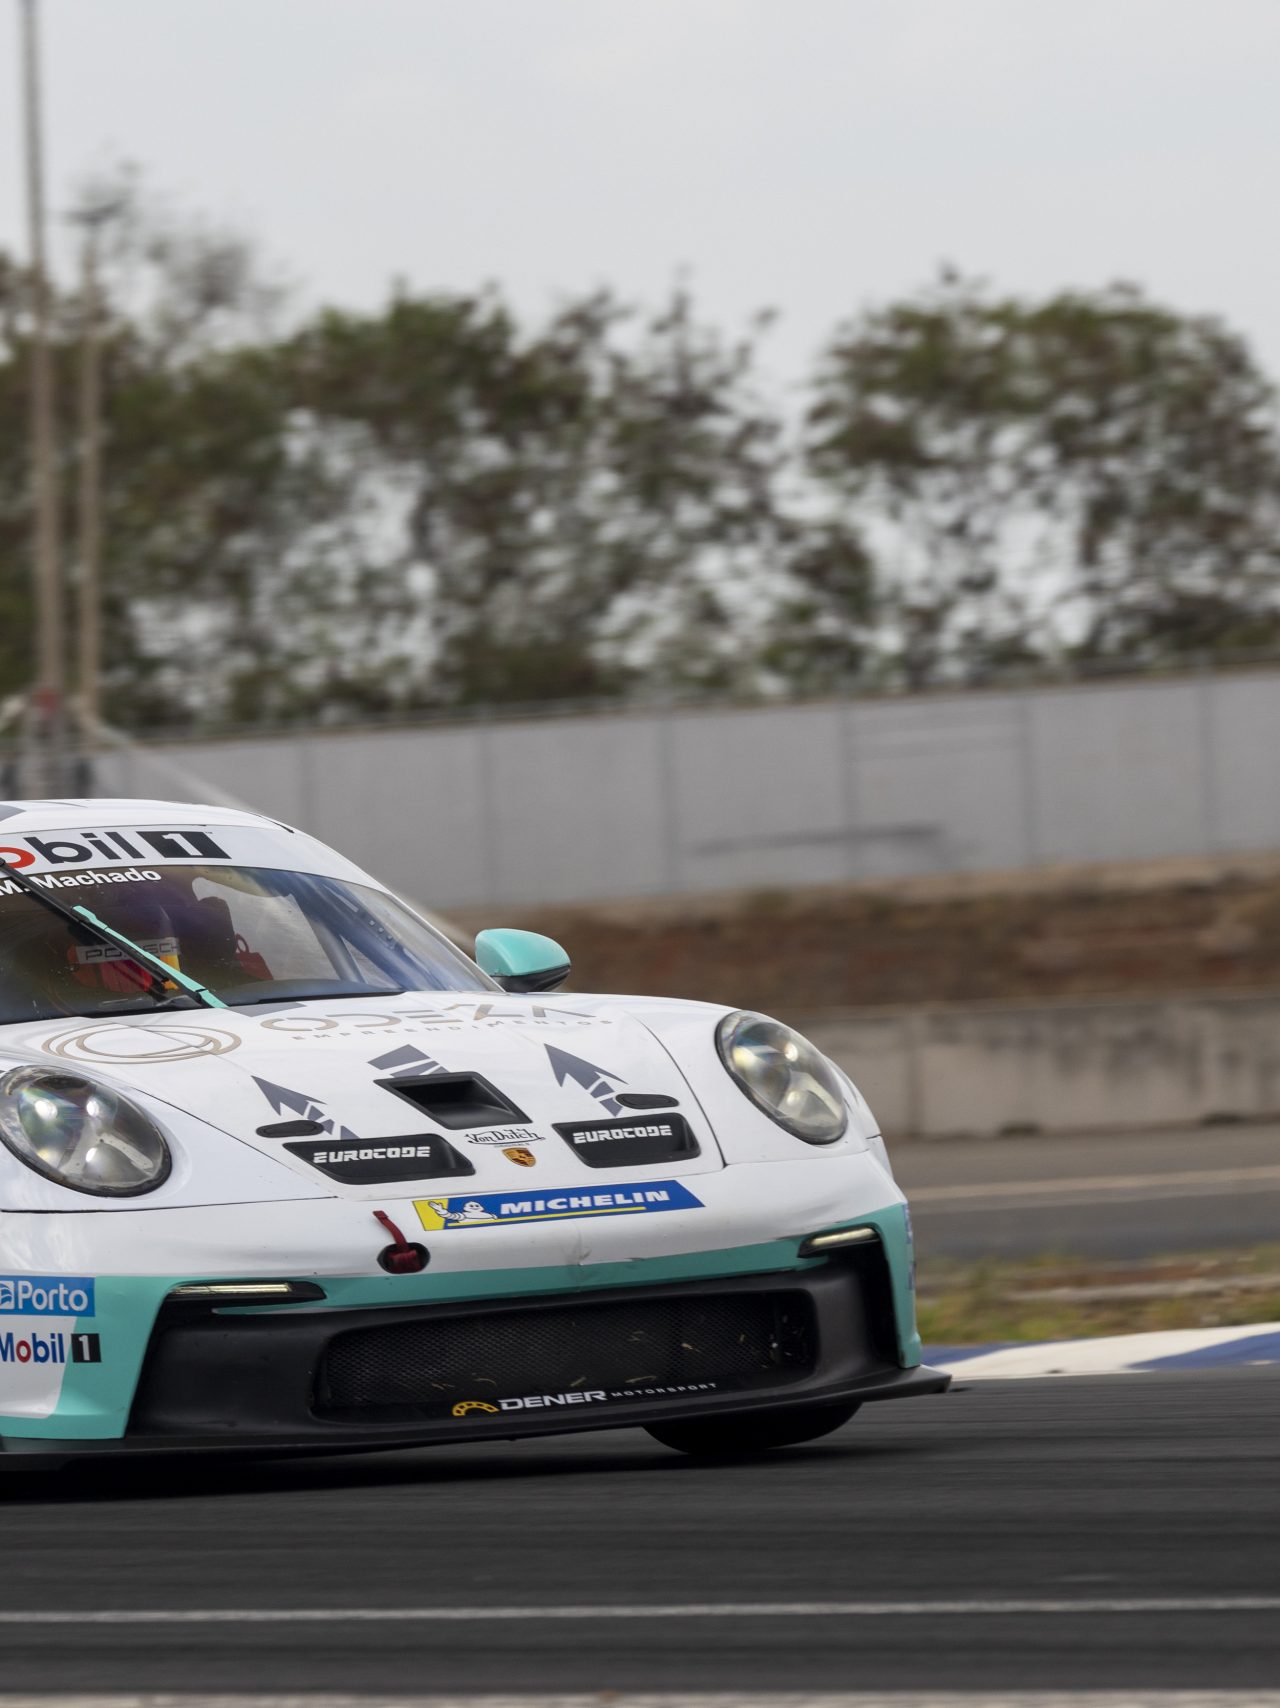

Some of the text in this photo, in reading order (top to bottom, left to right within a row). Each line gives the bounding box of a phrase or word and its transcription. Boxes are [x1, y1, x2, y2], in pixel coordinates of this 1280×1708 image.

[29, 867, 162, 889] Machado
[259, 1004, 597, 1032] ODEZA
[292, 1019, 613, 1041] EMPREENDIMENTOS
[490, 1128, 545, 1141] Dutch
[572, 1124, 673, 1145] EUROCODE
[313, 1146, 431, 1164] EUROCODE
[499, 1190, 670, 1216] MICHELIN
[17, 1280, 89, 1312] Porto
[498, 1382, 717, 1411] DENER MOTORSPORT
